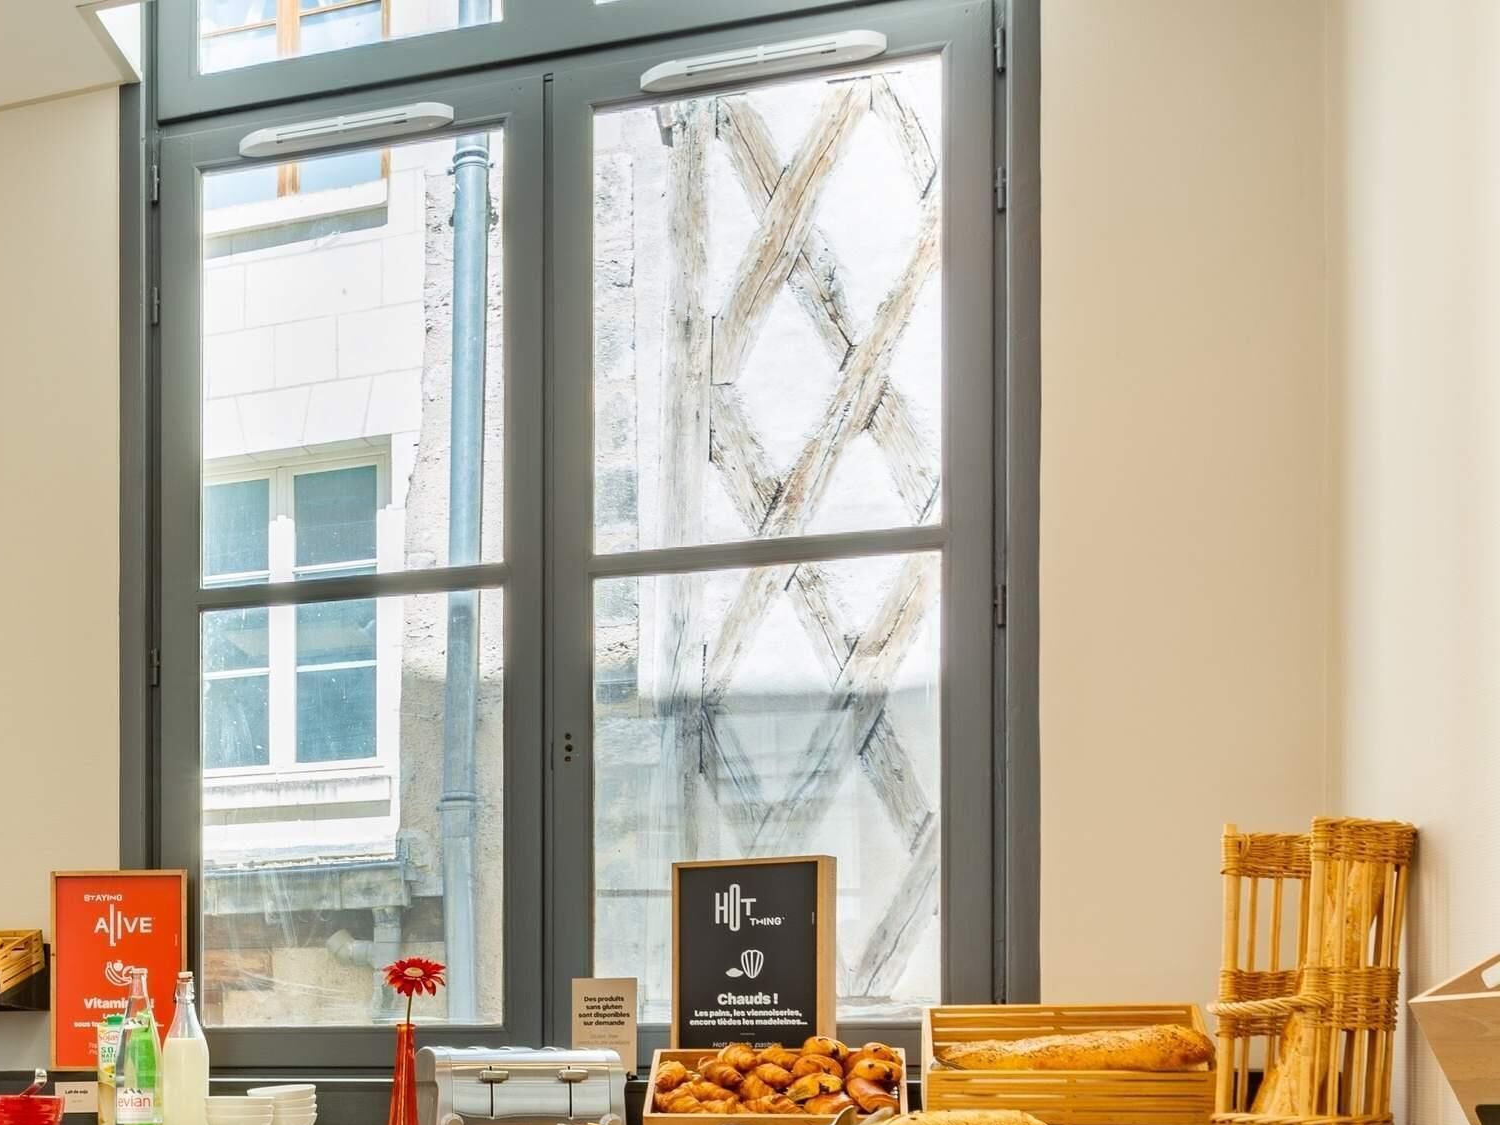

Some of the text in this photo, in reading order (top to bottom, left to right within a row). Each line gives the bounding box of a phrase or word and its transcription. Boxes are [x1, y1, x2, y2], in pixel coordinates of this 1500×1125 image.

[84, 894, 123, 902] STAYING
[715, 883, 757, 932] HOT
[94, 903, 152, 946] ALIVE
[750, 917, 782, 926] THING
[597, 995, 624, 1003] produits
[717, 992, 778, 1005] Chauds !
[593, 1011, 630, 1019] disponibles
[733, 1009, 746, 1017] les
[717, 1018, 742, 1026] tièdes
[742, 1018, 754, 1026] les
[118, 1096, 151, 1107] evian
